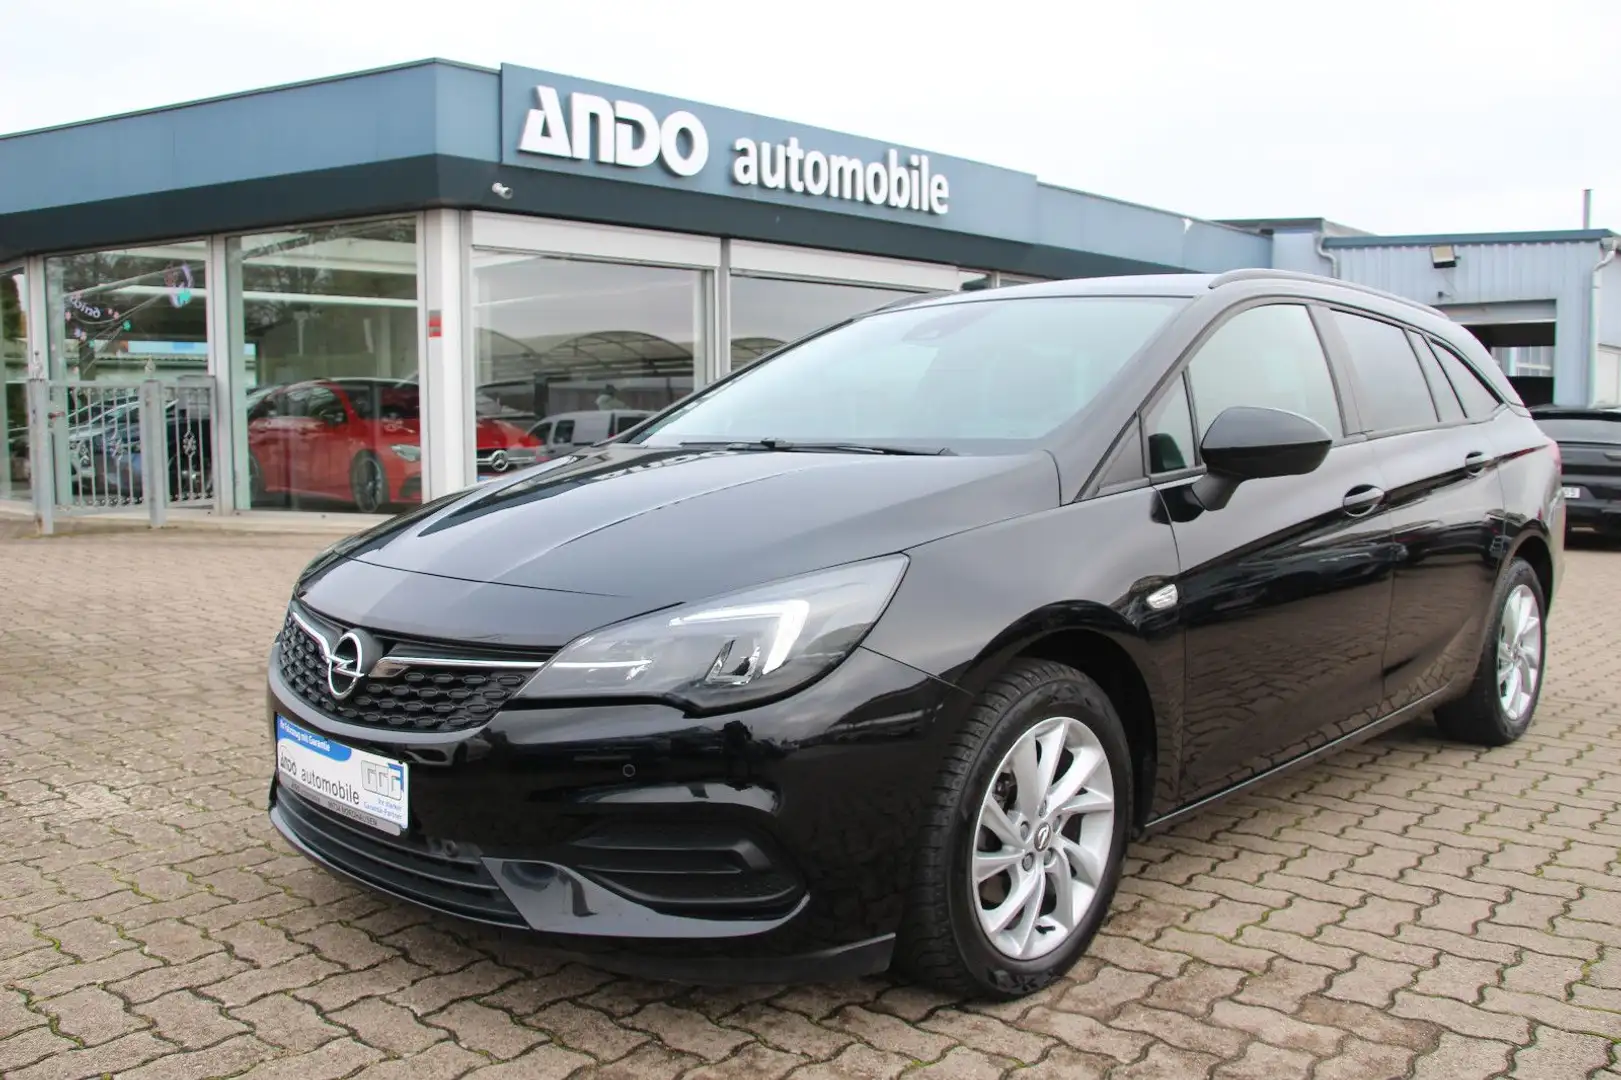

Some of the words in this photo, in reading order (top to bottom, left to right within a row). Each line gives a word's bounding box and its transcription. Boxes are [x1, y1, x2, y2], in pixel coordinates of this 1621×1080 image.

[517, 84, 709, 177] ANDO
[733, 135, 949, 215] automobile
[280, 752, 297, 776] ANDO
[302, 768, 359, 805] automobile
